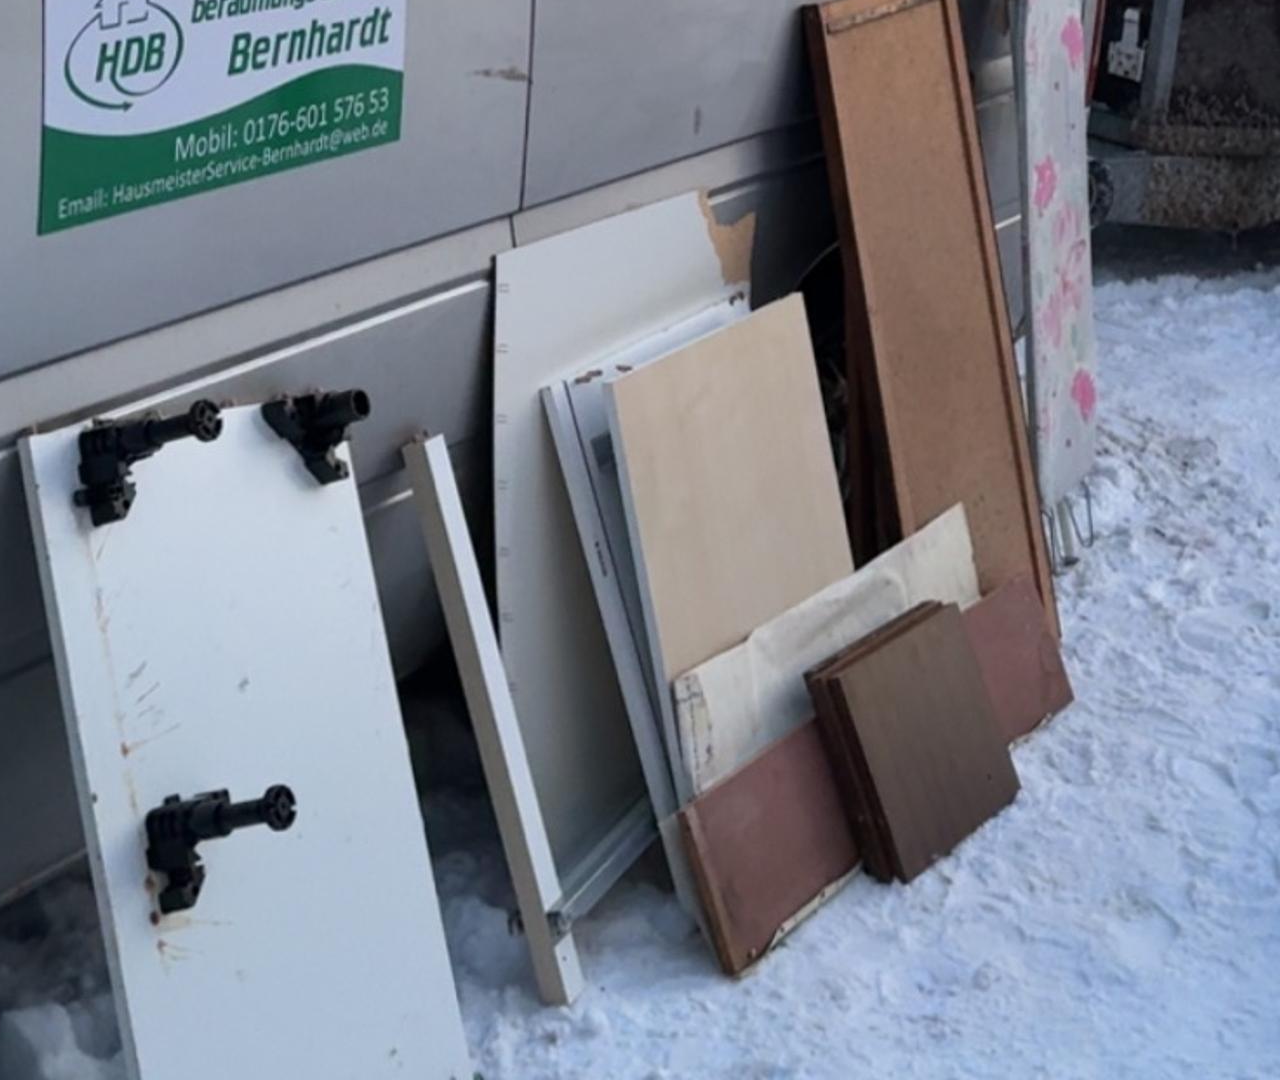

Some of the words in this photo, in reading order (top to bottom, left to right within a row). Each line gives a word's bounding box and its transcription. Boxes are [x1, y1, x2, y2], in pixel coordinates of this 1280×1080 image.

[95, 33, 166, 83] HDB
[227, 7, 392, 76] Bernhardt
[175, 129, 238, 162] Mobil:
[243, 102, 328, 145] 0176-601
[333, 93, 365, 123] 576
[368, 88, 390, 113] 53
[57, 190, 109, 220] Email:
[112, 120, 388, 205] HausmeisterService-Bernhardt@web.de
